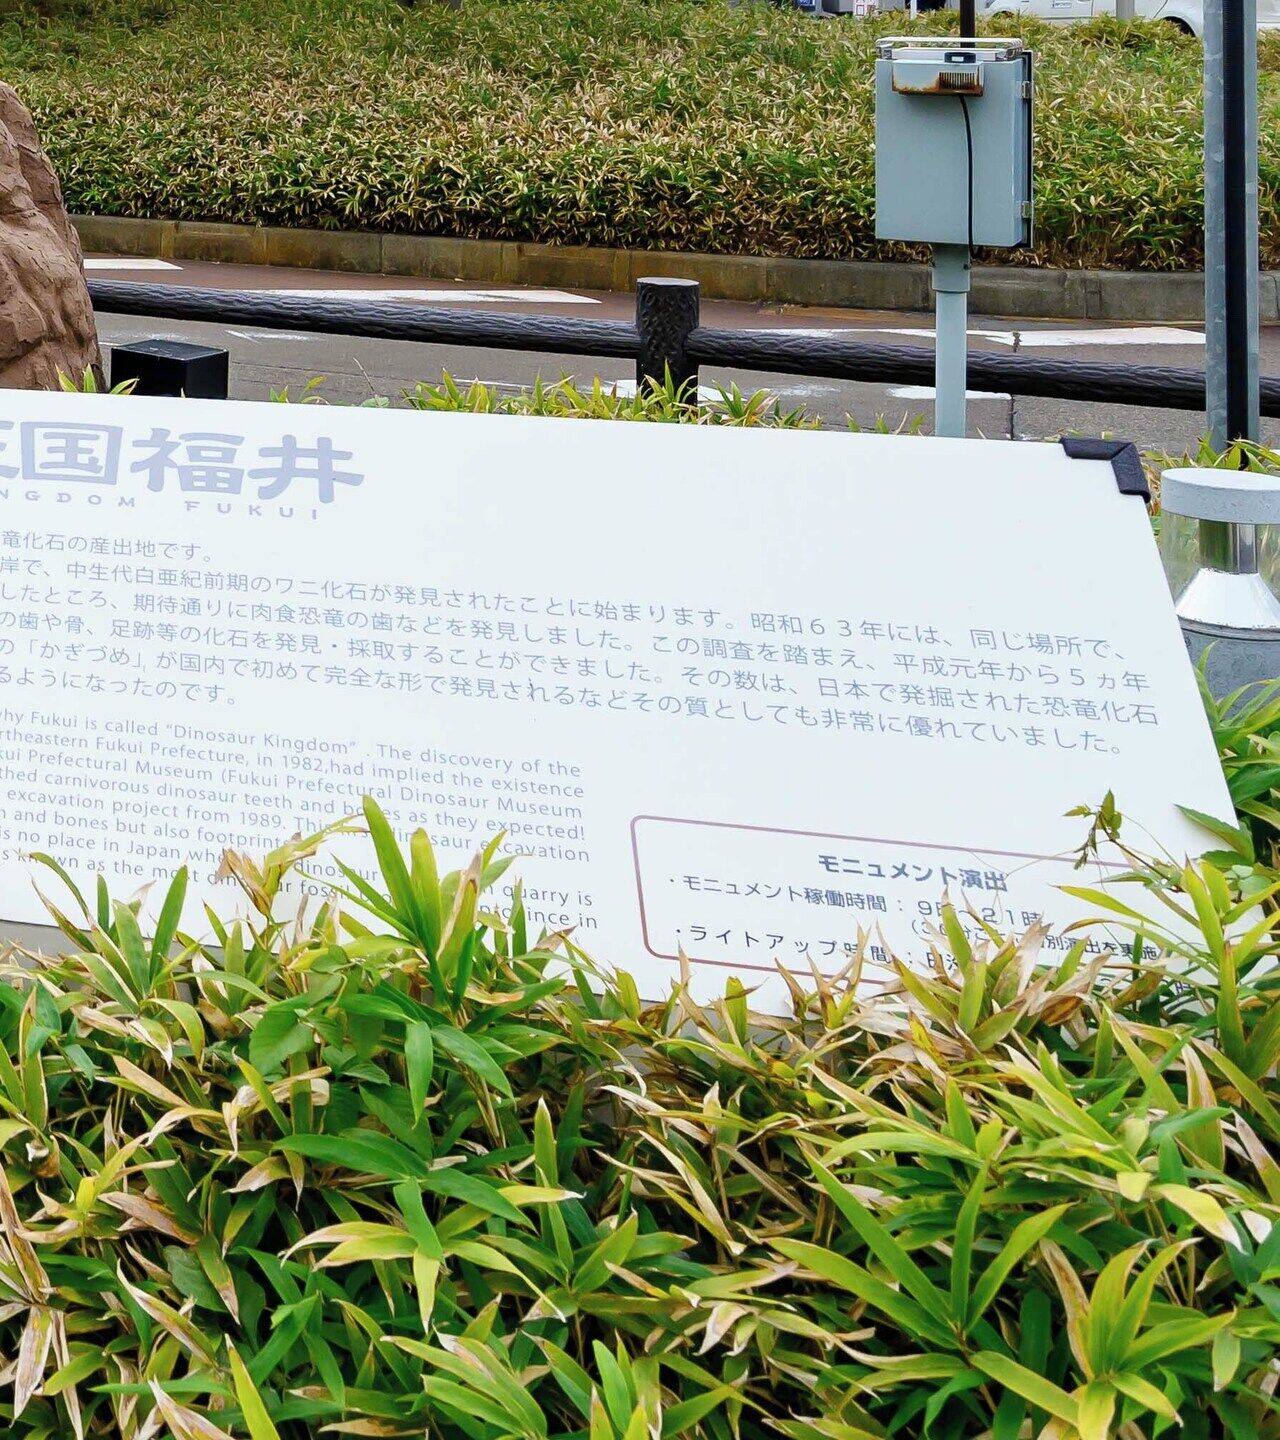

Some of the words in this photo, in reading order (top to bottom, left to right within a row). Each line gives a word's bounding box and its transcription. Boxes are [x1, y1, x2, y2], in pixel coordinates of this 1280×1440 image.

[184, 499, 320, 521] FUKUI
[29, 710, 78, 728] Fukui
[84, 715, 98, 731] is
[103, 718, 158, 736] called
[165, 723, 256, 745] “Dinosaur
[262, 732, 356, 754] Kingdom”
[375, 742, 412, 761] The
[419, 747, 513, 774] discovery
[520, 757, 541, 774] of
[546, 759, 581, 778] the
[27, 748, 127, 772] Prefectural
[134, 759, 213, 781] Museum
[220, 767, 278, 788] (Fukui
[285, 774, 392, 800] Prefectural
[399, 785, 489, 809] Dinosaur
[496, 796, 582, 819] Museum
[95, 735, 143, 754] Fukui
[149, 740, 249, 766] Prefecture,
[255, 751, 273, 767] in
[282, 754, 364, 776] 1982,had
[371, 763, 444, 784] implied
[450, 770, 484, 788] the
[490, 777, 584, 798] existence
[6, 788, 104, 810] excavation
[111, 799, 179, 819] project
[185, 804, 230, 823] from
[239, 810, 286, 830] 1989.
[12, 808, 47, 824] and
[53, 810, 108, 831] bones
[114, 816, 147, 835] but
[152, 822, 190, 840] also
[43, 772, 149, 794] carnivorous
[155, 781, 237, 803] dinosaur
[243, 792, 293, 809] teeth
[299, 798, 335, 814] and
[407, 810, 428, 824] as
[433, 810, 478, 833] they
[485, 819, 585, 841] expected!
[46, 831, 96, 850] place
[126, 839, 181, 860] Japan
[818, 854, 1009, 892] モニュメント演出
